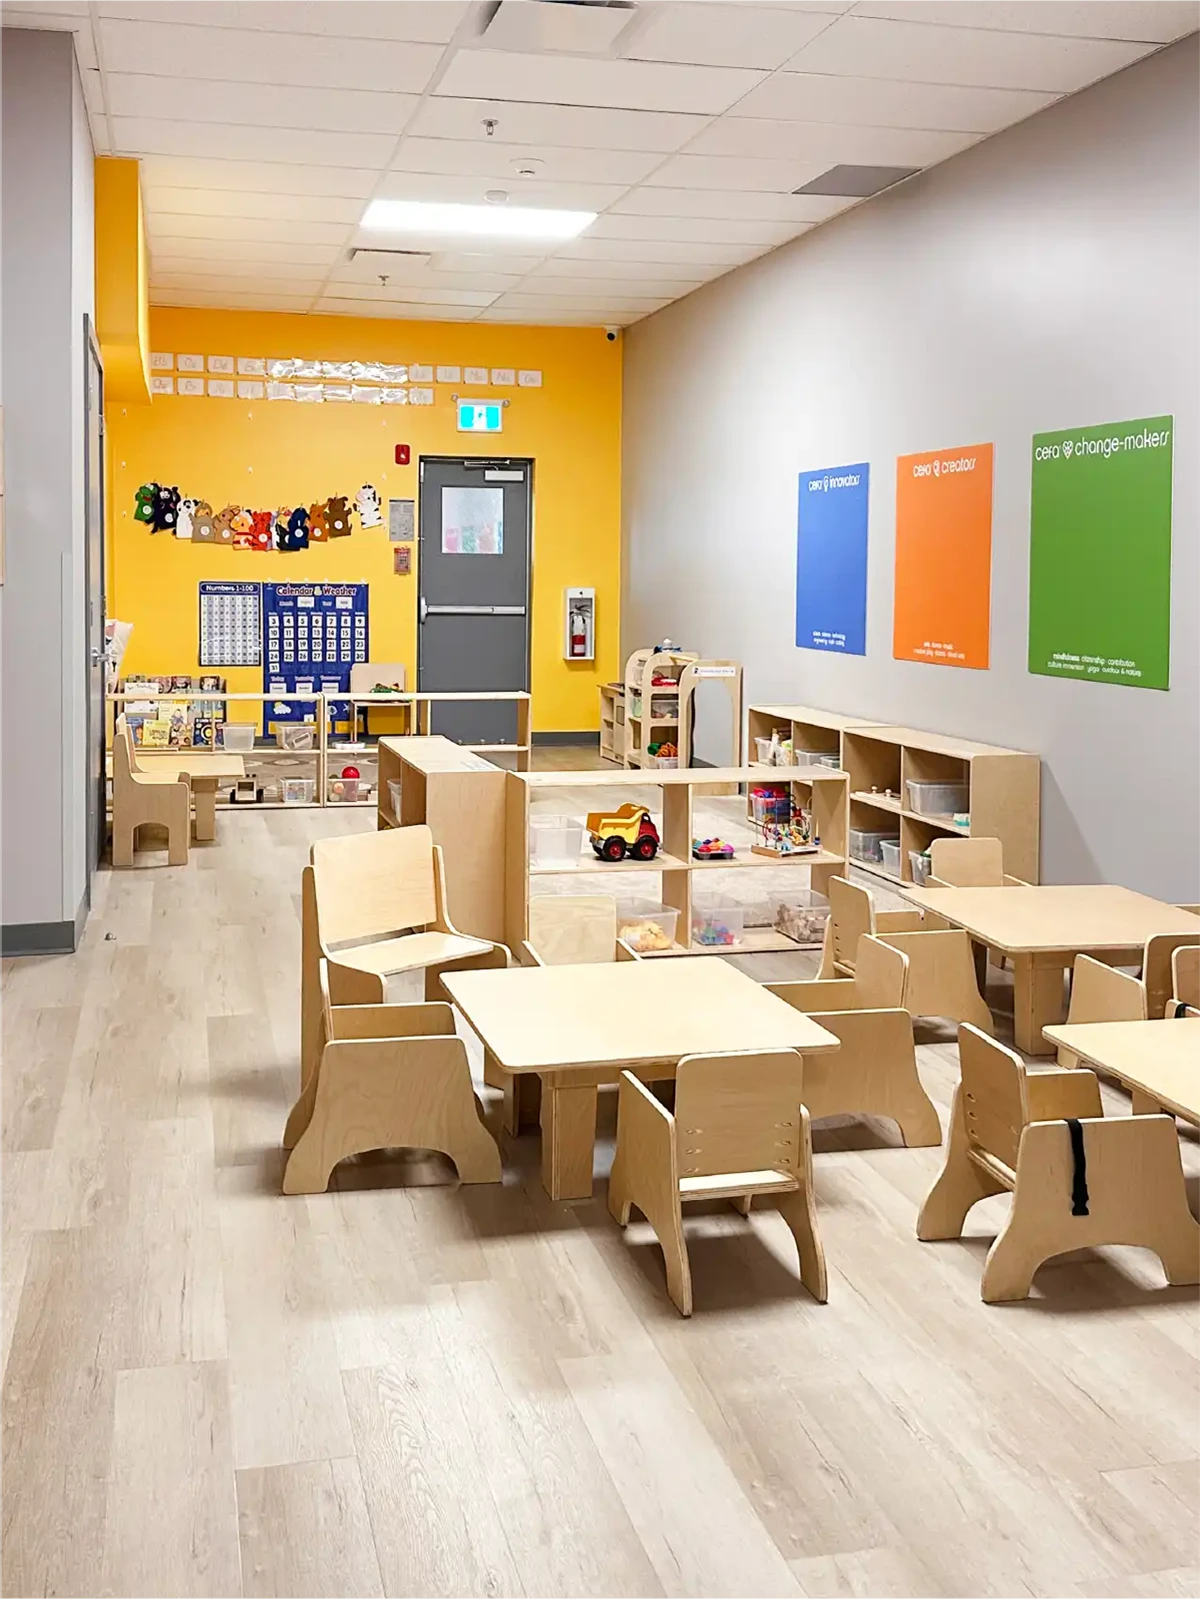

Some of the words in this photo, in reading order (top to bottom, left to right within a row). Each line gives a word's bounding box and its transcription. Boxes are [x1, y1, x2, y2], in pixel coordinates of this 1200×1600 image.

[1075, 428, 1169, 458] change-makers
[276, 586, 313, 596] Calendar
[322, 586, 357, 596] Weather
